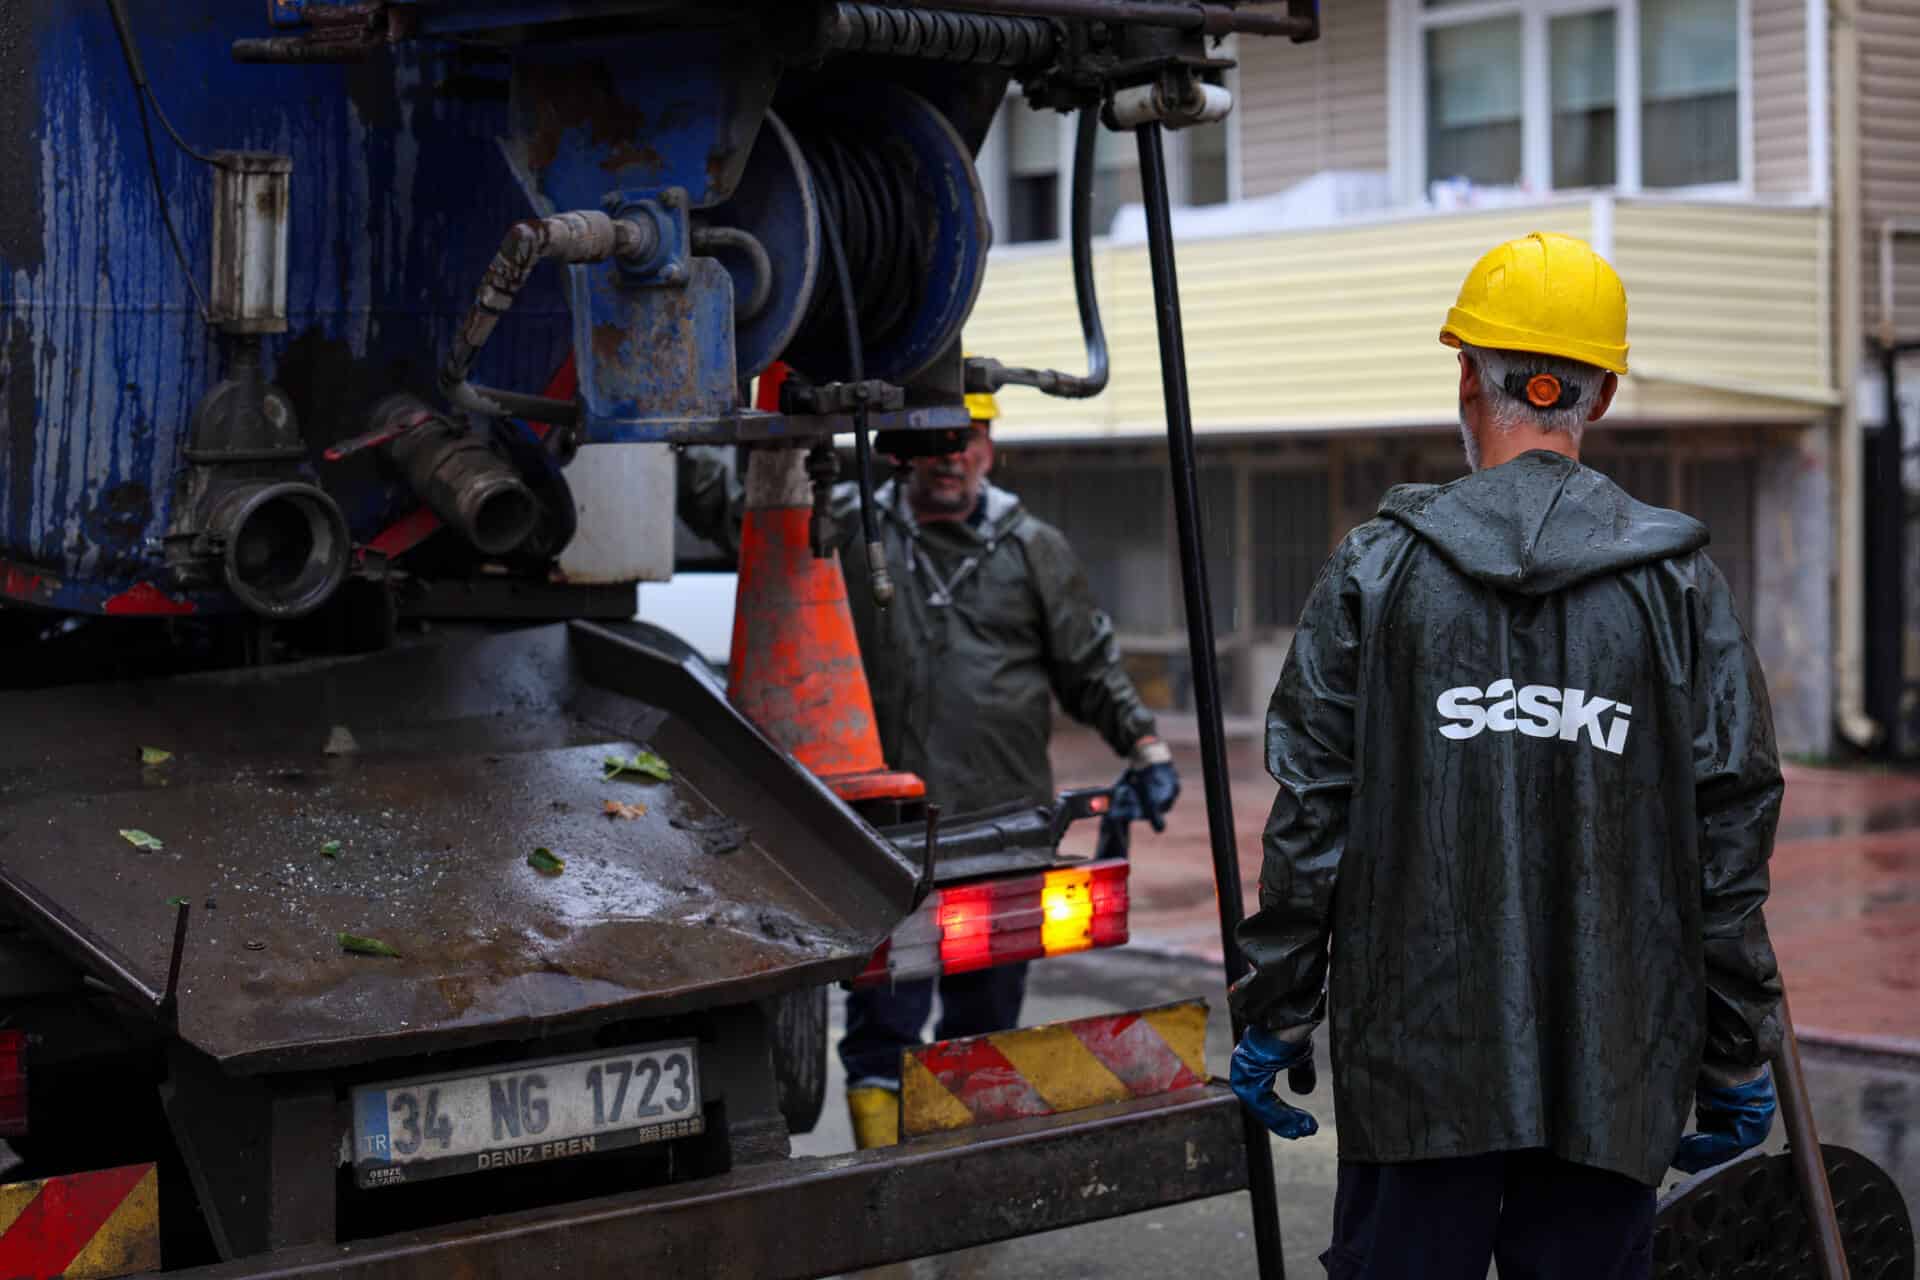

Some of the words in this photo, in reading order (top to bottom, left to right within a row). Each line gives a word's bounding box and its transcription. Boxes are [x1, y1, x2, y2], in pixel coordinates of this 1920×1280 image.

[391, 1087, 453, 1155] 34
[489, 1074, 549, 1140] NG
[585, 1053, 690, 1126] 1723
[365, 1134, 387, 1152] TR
[541, 1136, 596, 1160] FREN
